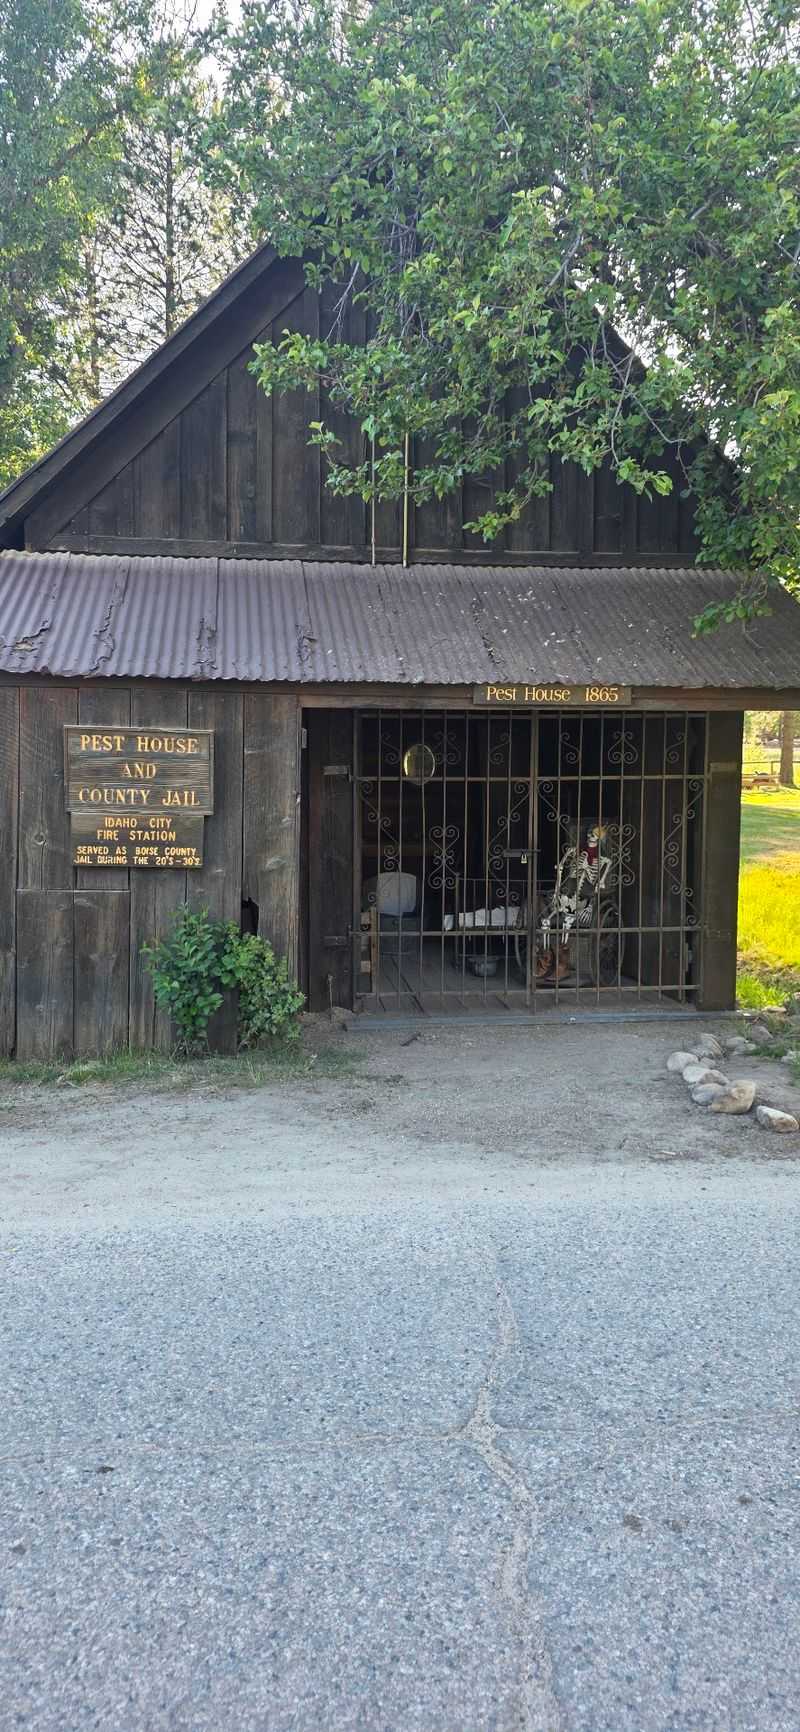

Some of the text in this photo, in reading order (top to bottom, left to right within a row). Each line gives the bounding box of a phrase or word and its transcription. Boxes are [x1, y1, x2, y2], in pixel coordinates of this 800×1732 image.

[486, 685, 618, 702] Pest House 1865
[80, 735, 199, 754] PEST HOUSE
[121, 763, 156, 779] AND
[79, 788, 200, 806] COUNTY JAIL
[105, 818, 172, 829] IDAHO CITY
[97, 830, 176, 841] FIRE STATION
[76, 846, 196, 857] SERVED AS BOISE COUNTY
[74, 856, 93, 864] JAIL
[97, 856, 127, 864] DURING
[133, 856, 149, 865] THE
